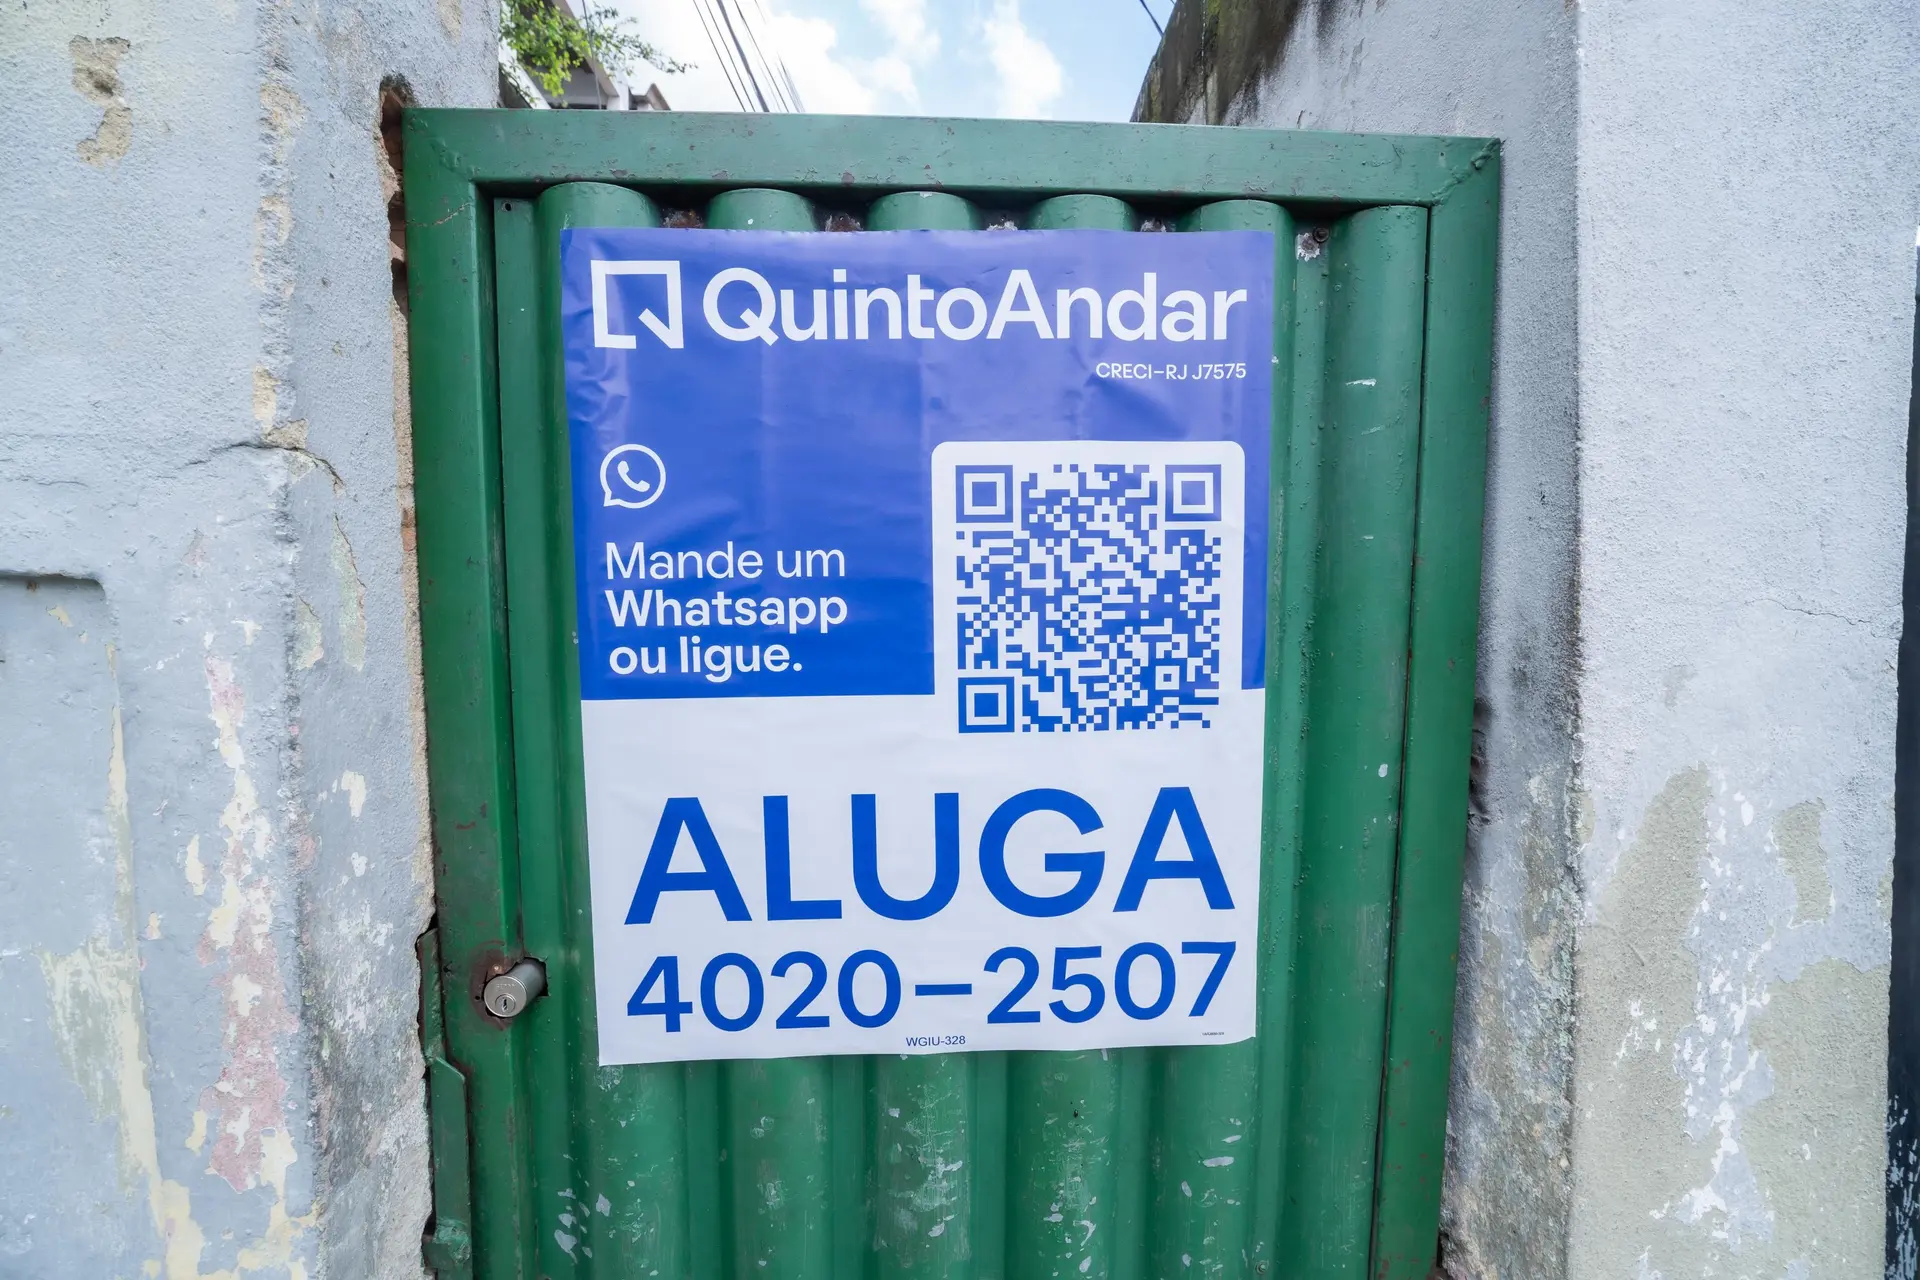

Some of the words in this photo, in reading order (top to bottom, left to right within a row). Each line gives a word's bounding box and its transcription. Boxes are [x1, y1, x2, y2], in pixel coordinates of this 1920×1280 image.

[703, 267, 1248, 346] QuintoAndar
[1095, 361, 1188, 380] CRECI-RJ
[1191, 362, 1247, 380] J7575
[606, 541, 763, 580] Mande
[776, 550, 845, 579] um
[604, 589, 848, 634] Whatsapp
[609, 646, 666, 675] ou
[679, 635, 802, 683] ligue.
[623, 786, 1236, 926] ALUGA
[905, 1035, 966, 1048] WGIU-328
